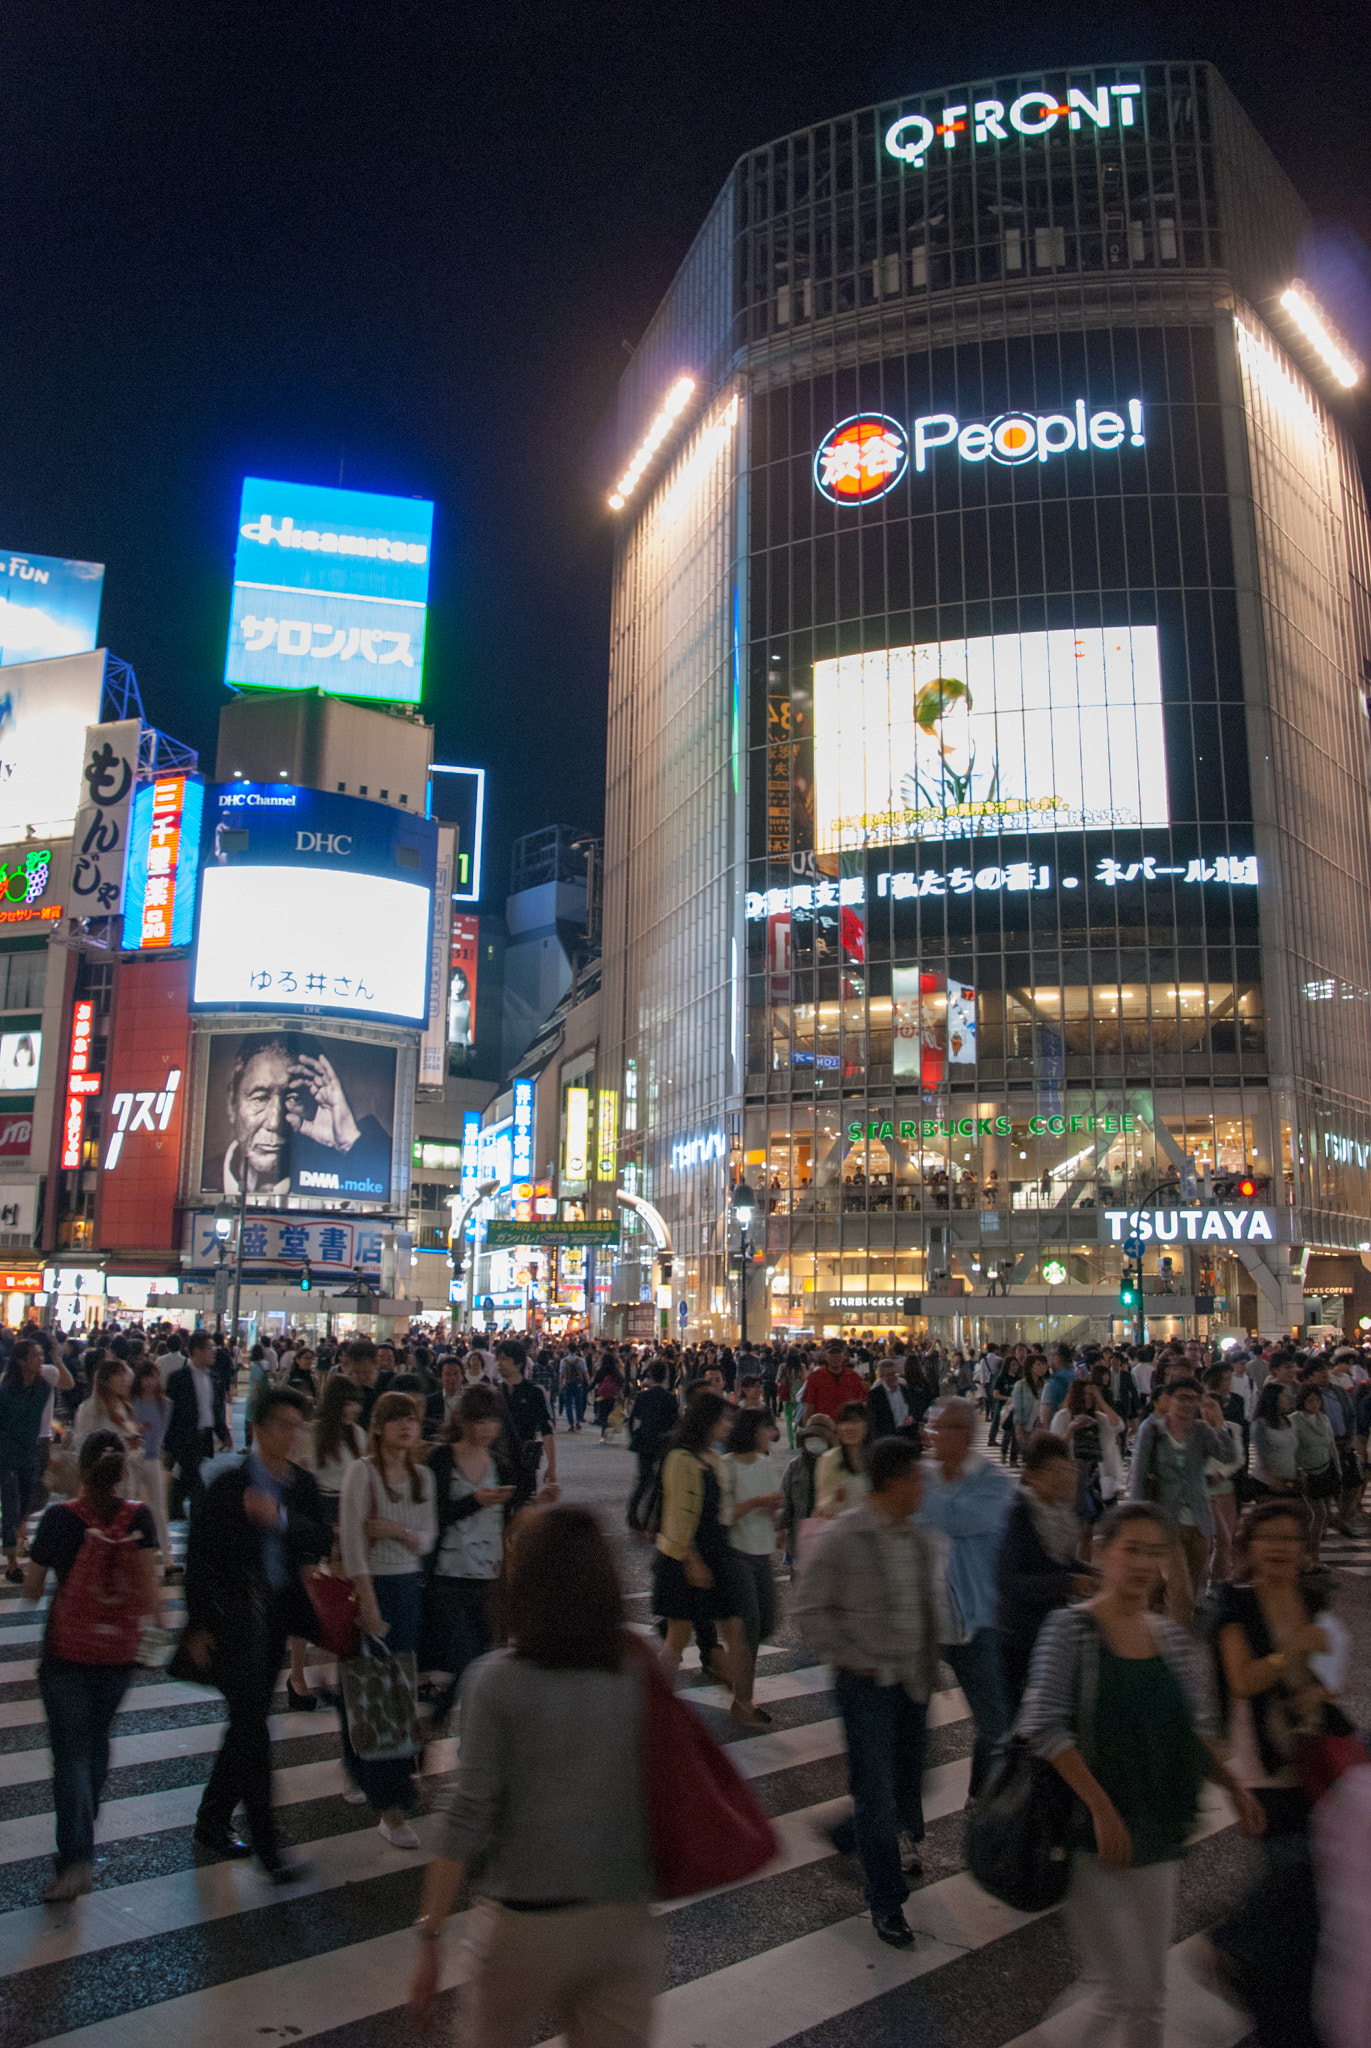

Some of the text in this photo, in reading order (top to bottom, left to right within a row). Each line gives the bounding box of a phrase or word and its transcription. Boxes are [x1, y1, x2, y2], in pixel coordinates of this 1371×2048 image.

[885, 84, 1141, 168] QFRONT
[819, 398, 1145, 486] 渋谷 People!
[241, 514, 427, 564] Hisamitsu
[9, 556, 49, 585] FUN
[240, 615, 415, 668] サロンパス
[218, 793, 297, 807] DHC Channel
[72, 742, 132, 910] もんじゃ
[296, 831, 352, 855] DHC
[141, 783, 178, 939] 三千里薬品
[104, 1069, 181, 1170] クスリ
[848, 1114, 1136, 1142] STARBUCKS COFFEE
[1104, 1210, 1273, 1240] TSUTAYA
[829, 1296, 894, 1307] STARBUCKS
